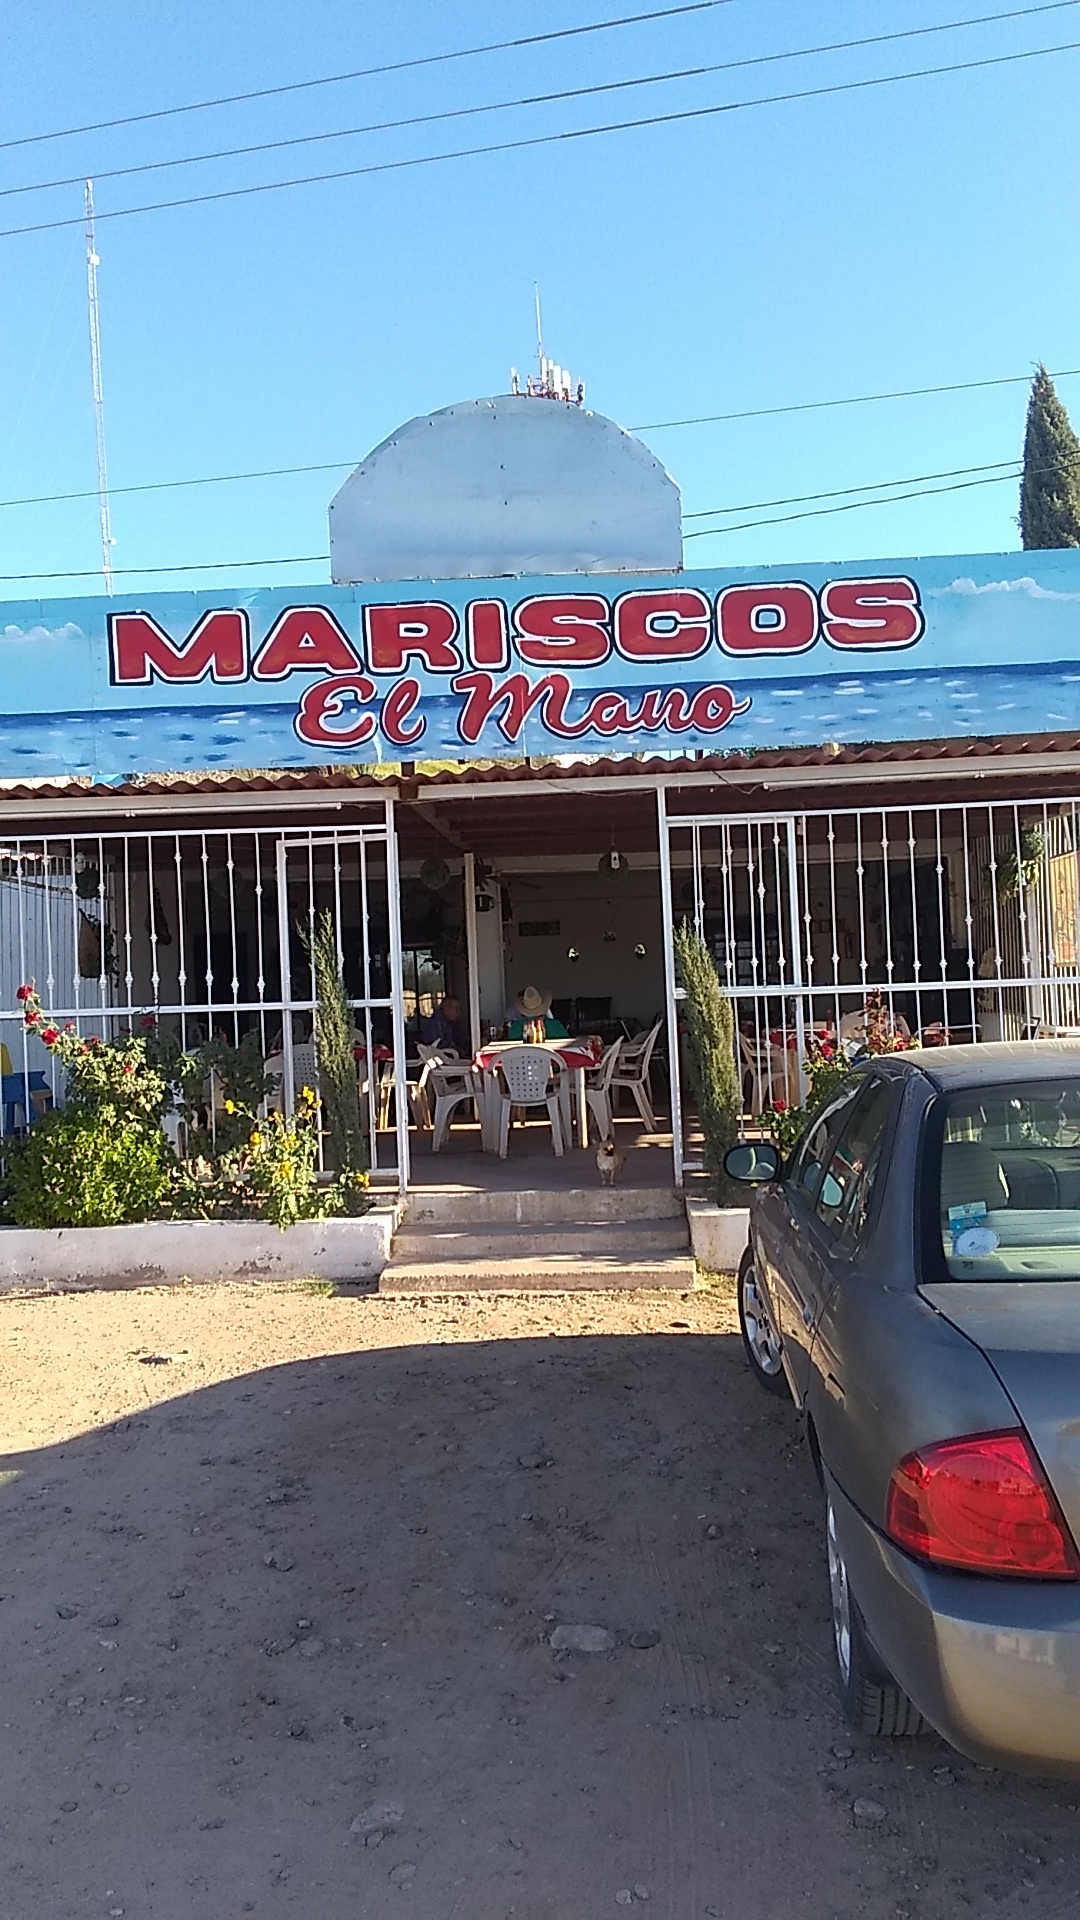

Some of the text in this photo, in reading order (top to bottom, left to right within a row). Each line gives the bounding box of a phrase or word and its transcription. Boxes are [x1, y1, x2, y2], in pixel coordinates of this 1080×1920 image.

[107, 575, 924, 686] MARISCOS
[294, 668, 752, 749] El Mano
